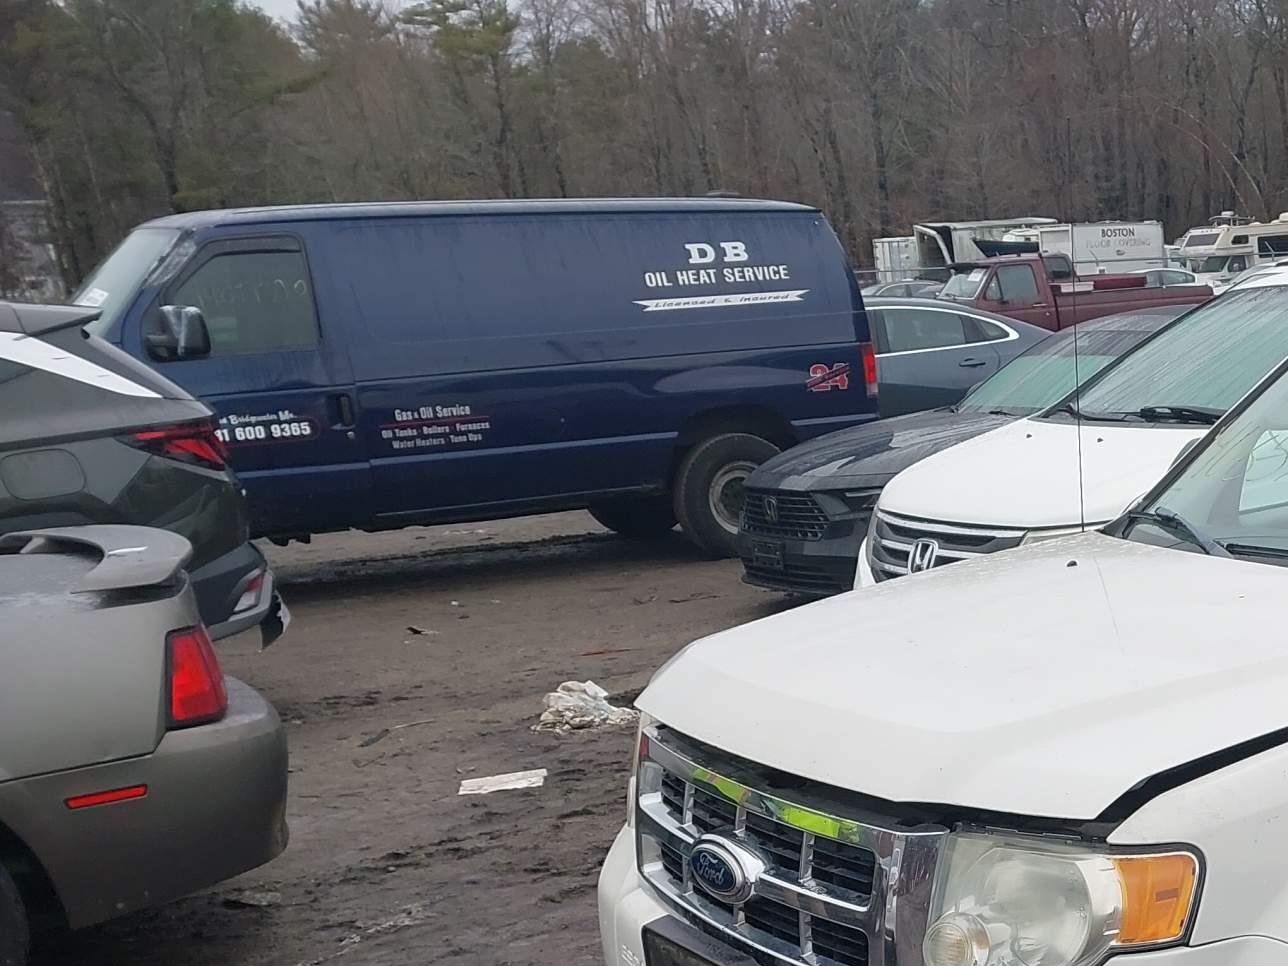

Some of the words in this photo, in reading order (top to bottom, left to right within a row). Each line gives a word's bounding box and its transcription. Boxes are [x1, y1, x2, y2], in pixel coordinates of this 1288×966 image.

[1101, 228, 1134, 238] BOSTON
[644, 271, 673, 287] OIL
[676, 269, 716, 286] HEAT
[723, 265, 790, 283] SERVICE
[394, 409, 413, 421] Gas
[420, 406, 433, 419] Oil
[436, 404, 471, 417] Service
[235, 426, 265, 441] 600
[270, 421, 311, 437] 9365
[381, 430, 393, 438] Oil
[395, 427, 418, 437] Tanks
[392, 440, 415, 449] Water
[415, 438, 445, 447] Heaters
[697, 852, 726, 886] Ford
